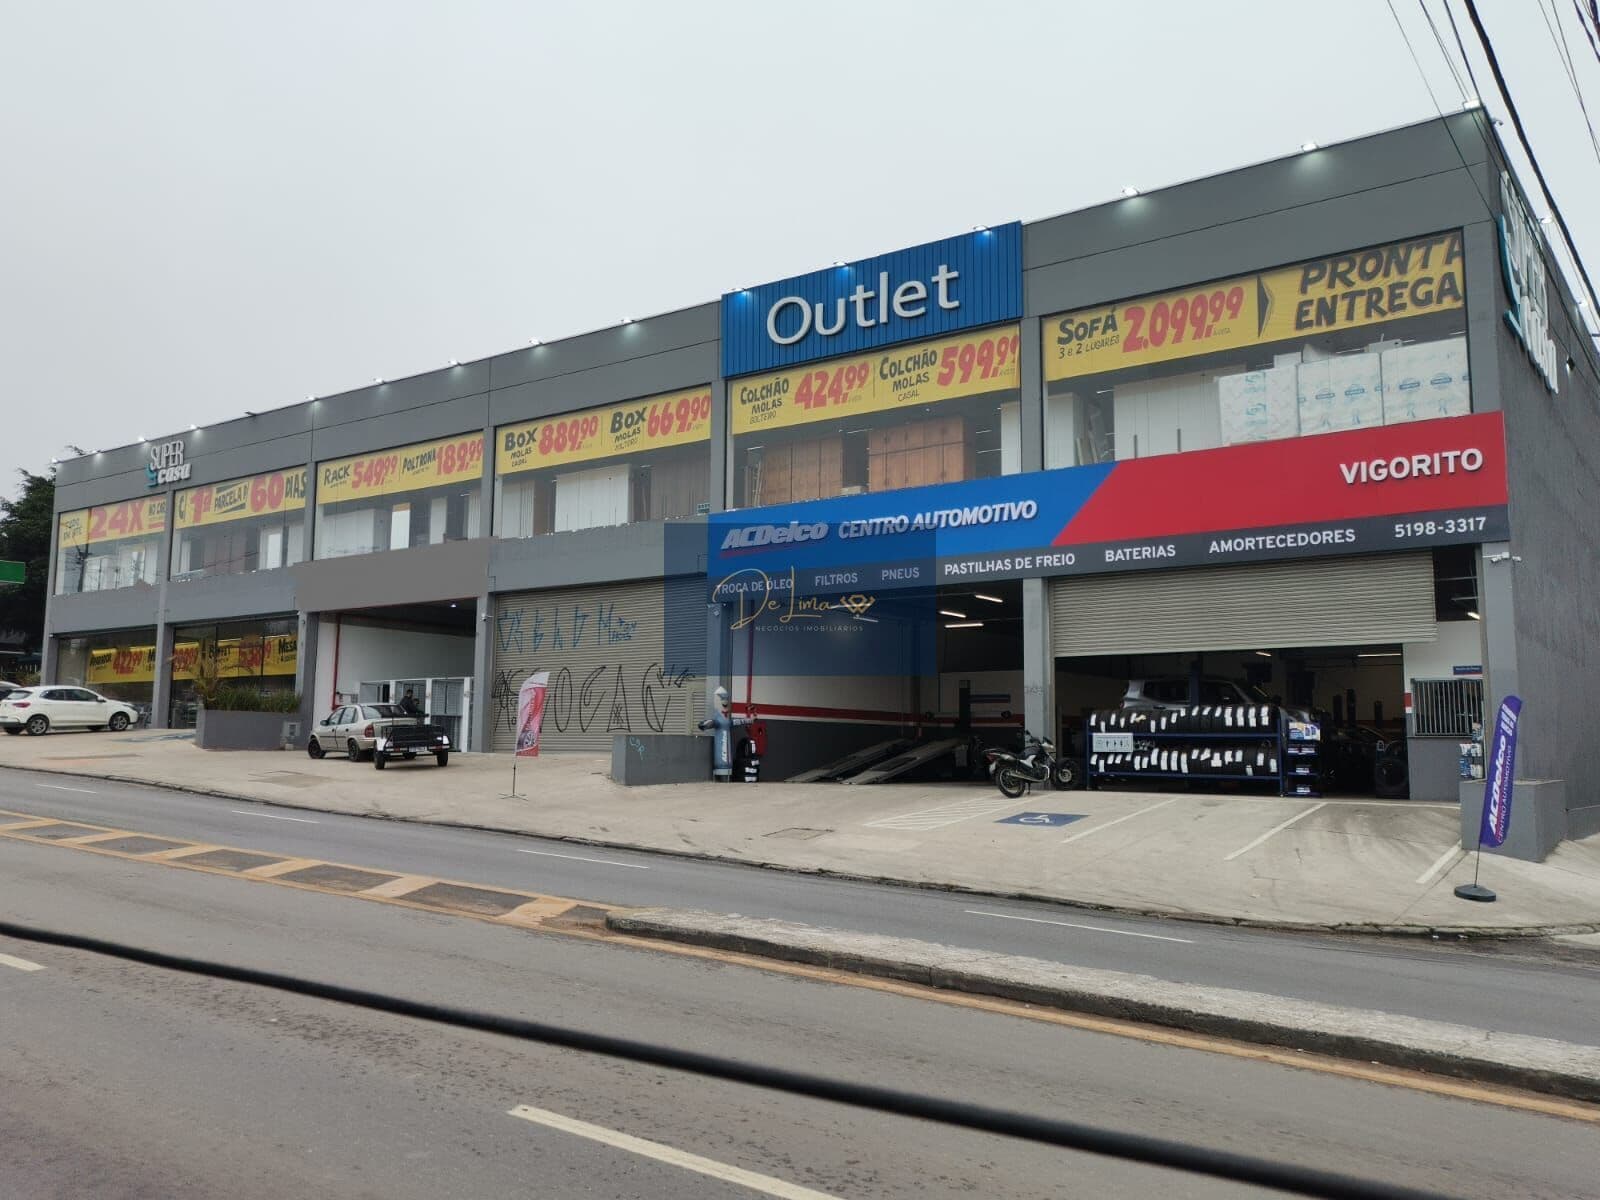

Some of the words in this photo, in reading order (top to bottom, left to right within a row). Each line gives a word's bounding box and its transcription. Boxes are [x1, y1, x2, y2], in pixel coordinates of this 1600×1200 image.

[1300, 232, 1462, 295] PRONTA
[766, 264, 959, 345] Outlet
[1294, 271, 1462, 331] ENTREGA
[1122, 286, 1244, 353] 2.099,99
[1058, 347, 1065, 359] 3
[1076, 343, 1082, 354] 2
[1085, 334, 1120, 353] LUGARES
[878, 348, 938, 381] COLCHÃO
[740, 377, 789, 406] COLCHÃO
[892, 371, 930, 393] MOLAS
[897, 388, 921, 403] CASAL
[751, 397, 783, 415] MOLAS
[614, 426, 641, 443] MOLAS
[151, 440, 184, 470] SUPER
[401, 447, 436, 474] POLTRONA
[510, 446, 532, 460] MOLAS
[1339, 447, 1485, 485] VIGORITO
[157, 463, 191, 484] casa
[323, 463, 351, 487] RACK
[250, 473, 284, 513] 60
[88, 500, 146, 540] 24X
[720, 520, 829, 550] ACDelco
[838, 514, 912, 539] CENTRO
[911, 499, 1038, 531] AUTOMOTIVO
[716, 580, 750, 595] TROCA
[751, 579, 764, 592] DE
[815, 572, 858, 587] FILTROS
[881, 566, 920, 581] PNEUS
[944, 558, 1012, 576] PASTILHAS
[1015, 557, 1032, 570] DE
[1035, 552, 1076, 568] FREIO
[1105, 544, 1177, 563] BATERIAS
[1208, 527, 1356, 555] AMORTECEDORES
[1394, 516, 1487, 538] 5198-3317
[1488, 735, 1507, 835] ACDelco
